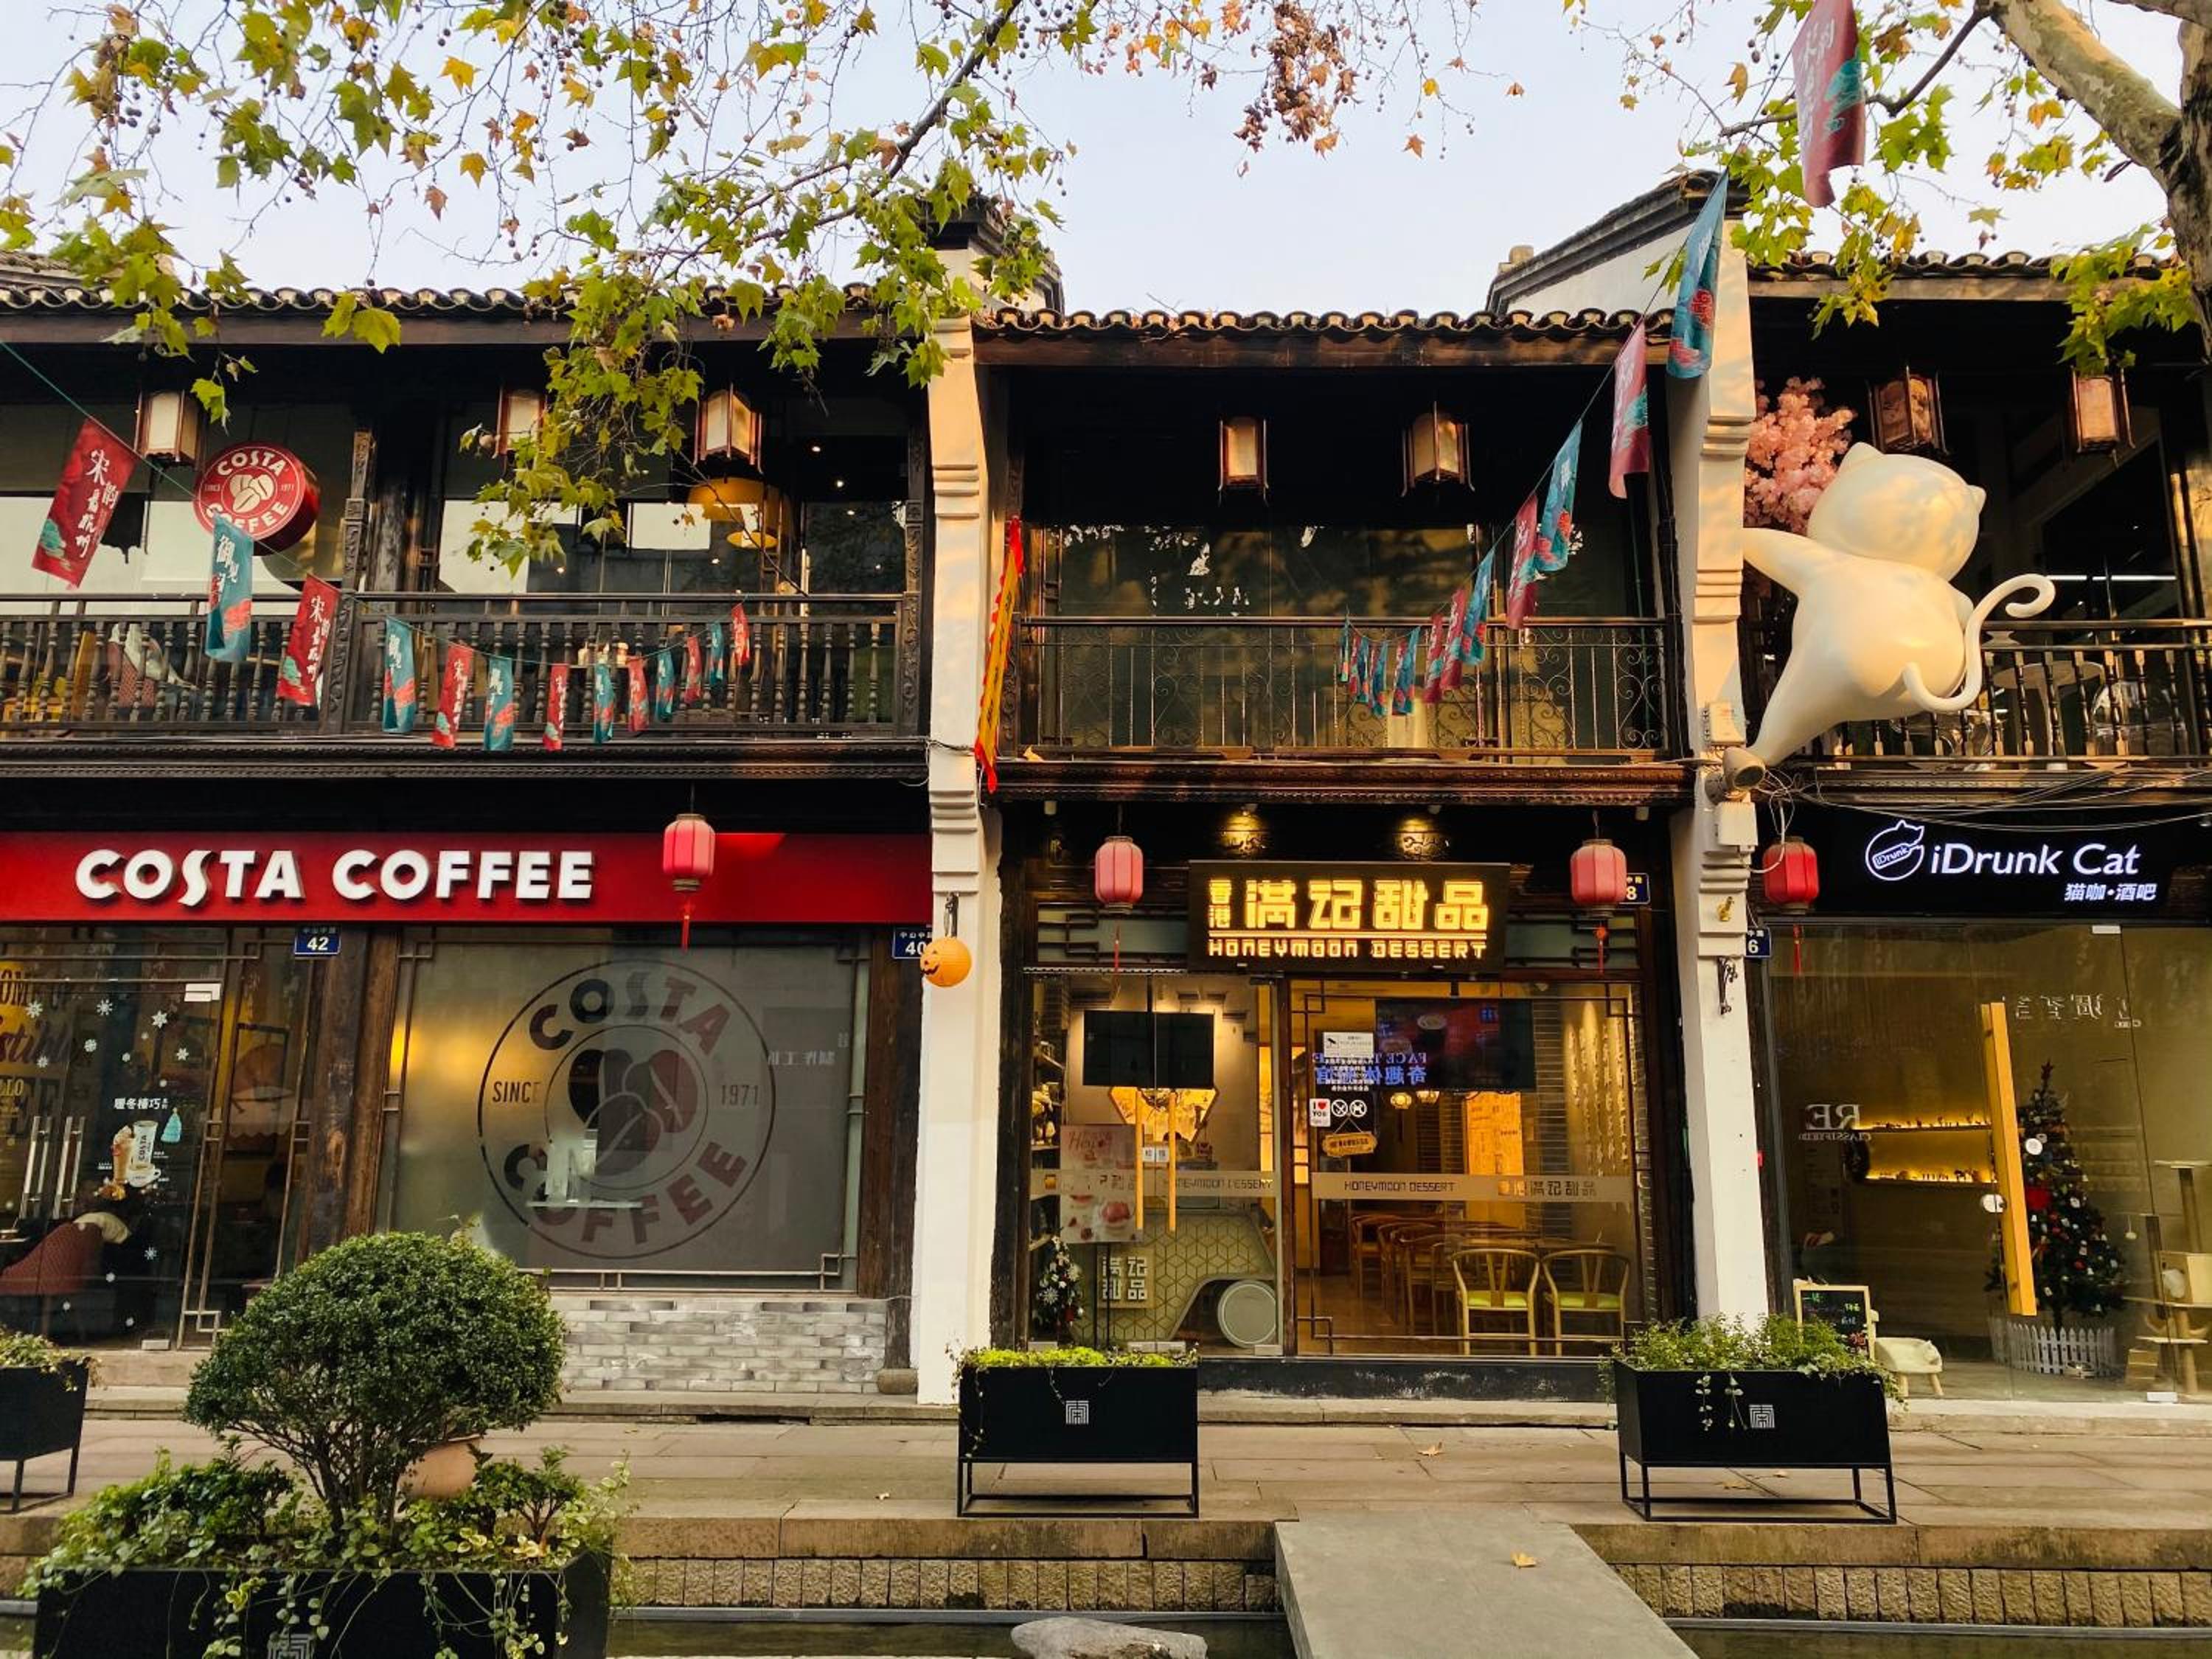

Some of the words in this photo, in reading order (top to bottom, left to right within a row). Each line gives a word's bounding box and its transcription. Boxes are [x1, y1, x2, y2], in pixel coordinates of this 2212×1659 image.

[218, 451, 286, 476] COSTA
[1930, 843, 2064, 875] iDrunk
[2072, 843, 2142, 875] Cat
[74, 849, 305, 906] COSTA
[332, 849, 593, 900] COFFEE
[2064, 883, 2157, 902] 猫咖·酒吧
[1245, 880, 1488, 930] 满记甜品
[307, 936, 330, 950] 42
[1208, 939, 1358, 958] HONEYMOON
[1371, 940, 1486, 959] DESSERT
[529, 972, 731, 1056] COSTA
[492, 1082, 541, 1104] SINCE
[722, 1085, 760, 1105] 1971
[1344, 1180, 1406, 1192] HONEYMOON
[1409, 1182, 1455, 1192] DESSERT
